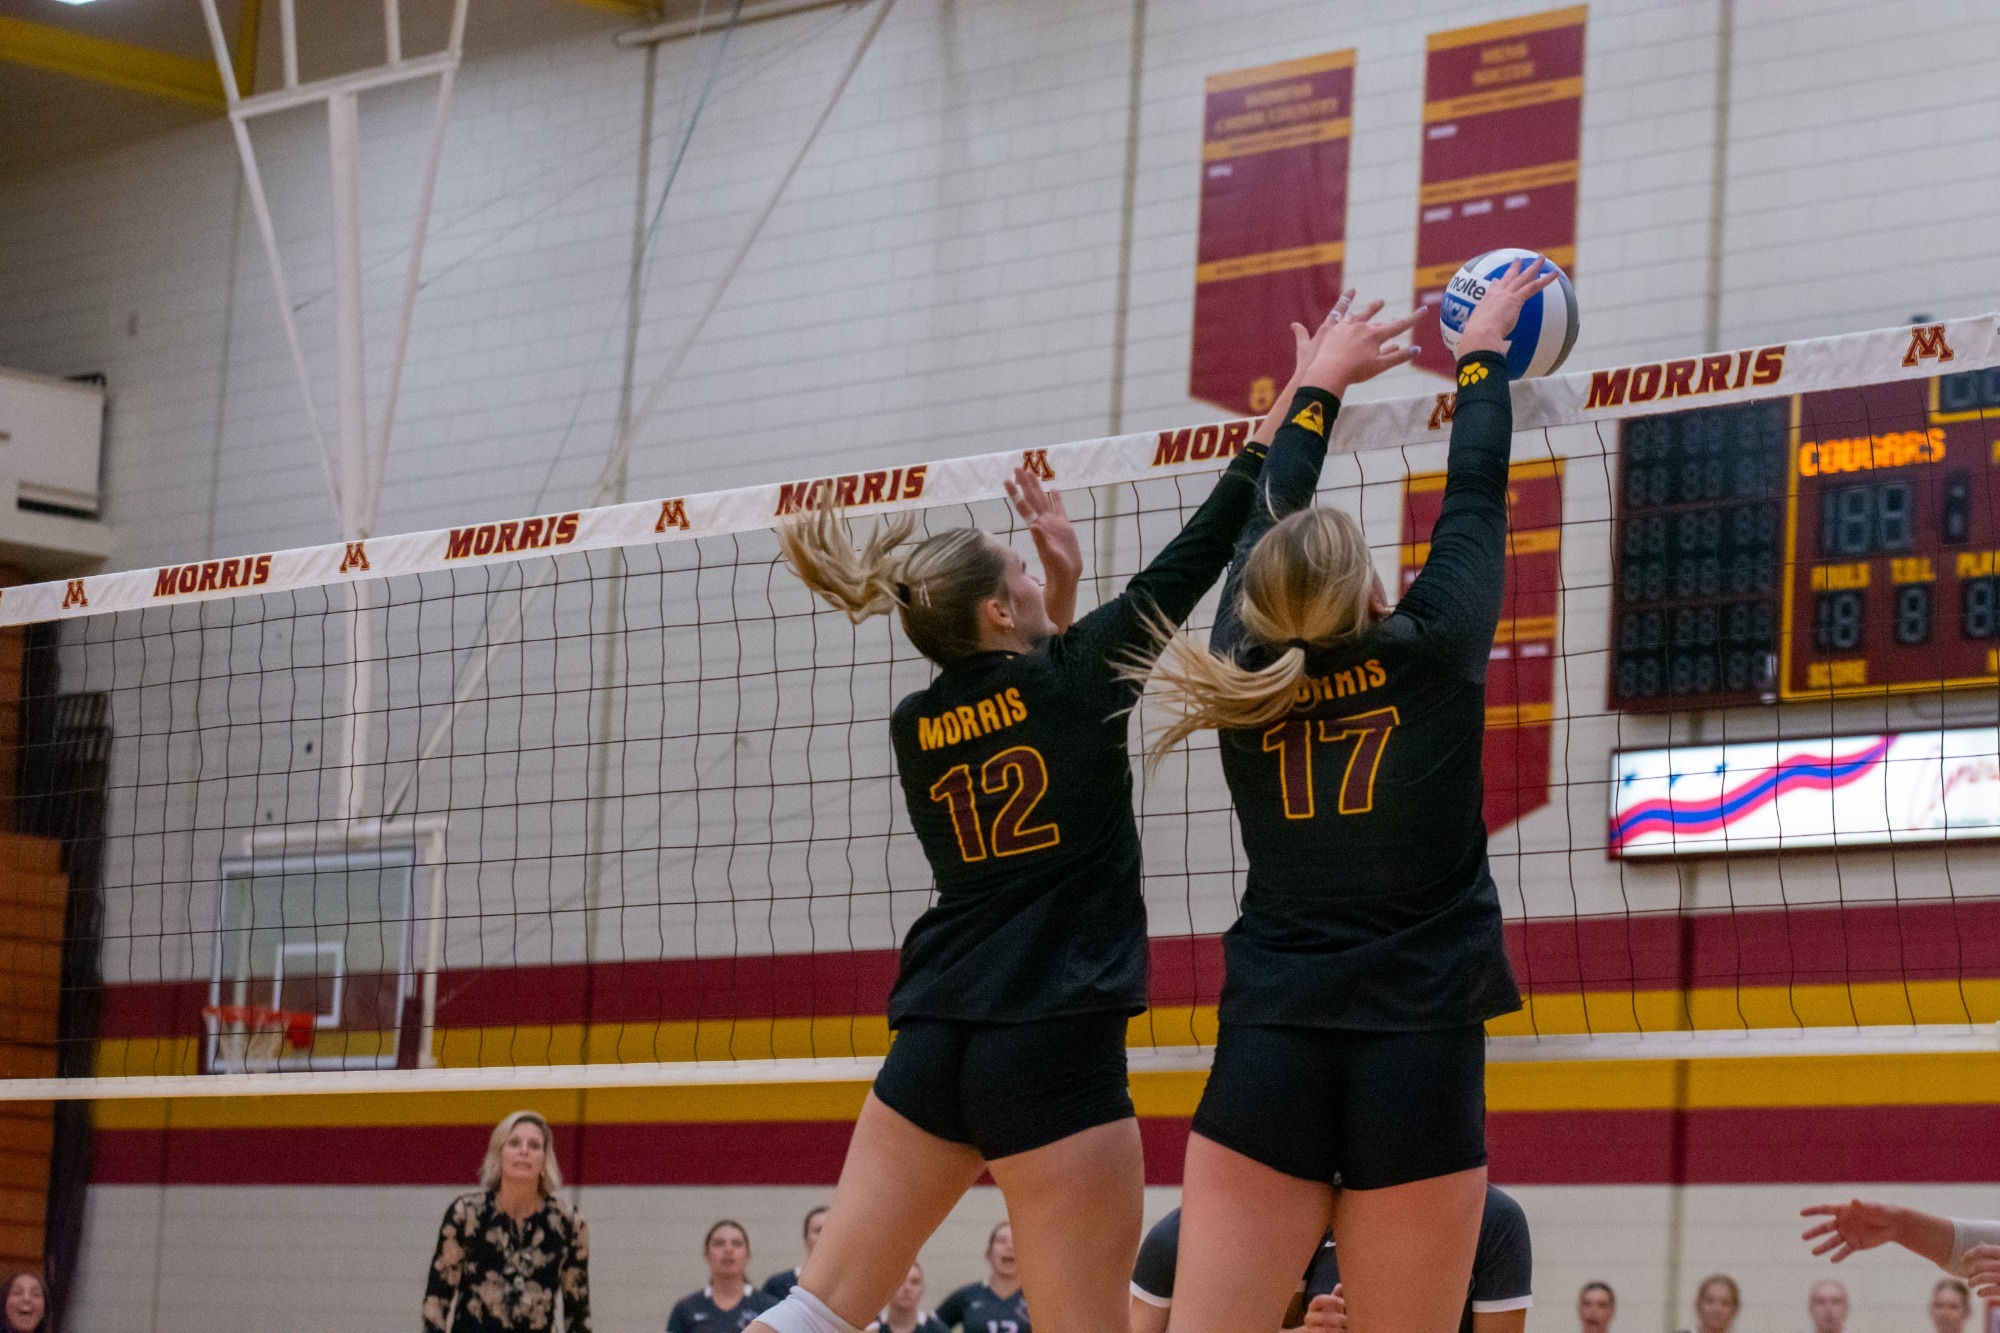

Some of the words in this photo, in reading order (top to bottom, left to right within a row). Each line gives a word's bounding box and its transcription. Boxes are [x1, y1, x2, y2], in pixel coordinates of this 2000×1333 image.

[1902, 323, 1954, 367] M
[1584, 344, 1787, 409] MORRIS
[1022, 448, 1056, 482] M
[1151, 418, 1267, 467] MOR
[774, 465, 928, 516] MORRIS
[444, 513, 580, 560] MORRIS
[655, 498, 691, 532] M
[153, 554, 272, 597] MORRIS
[339, 542, 370, 573] M
[62, 579, 88, 609] M
[918, 687, 1028, 751] MORRIS
[1263, 705, 1400, 819] 17
[930, 745, 1060, 862] 12
